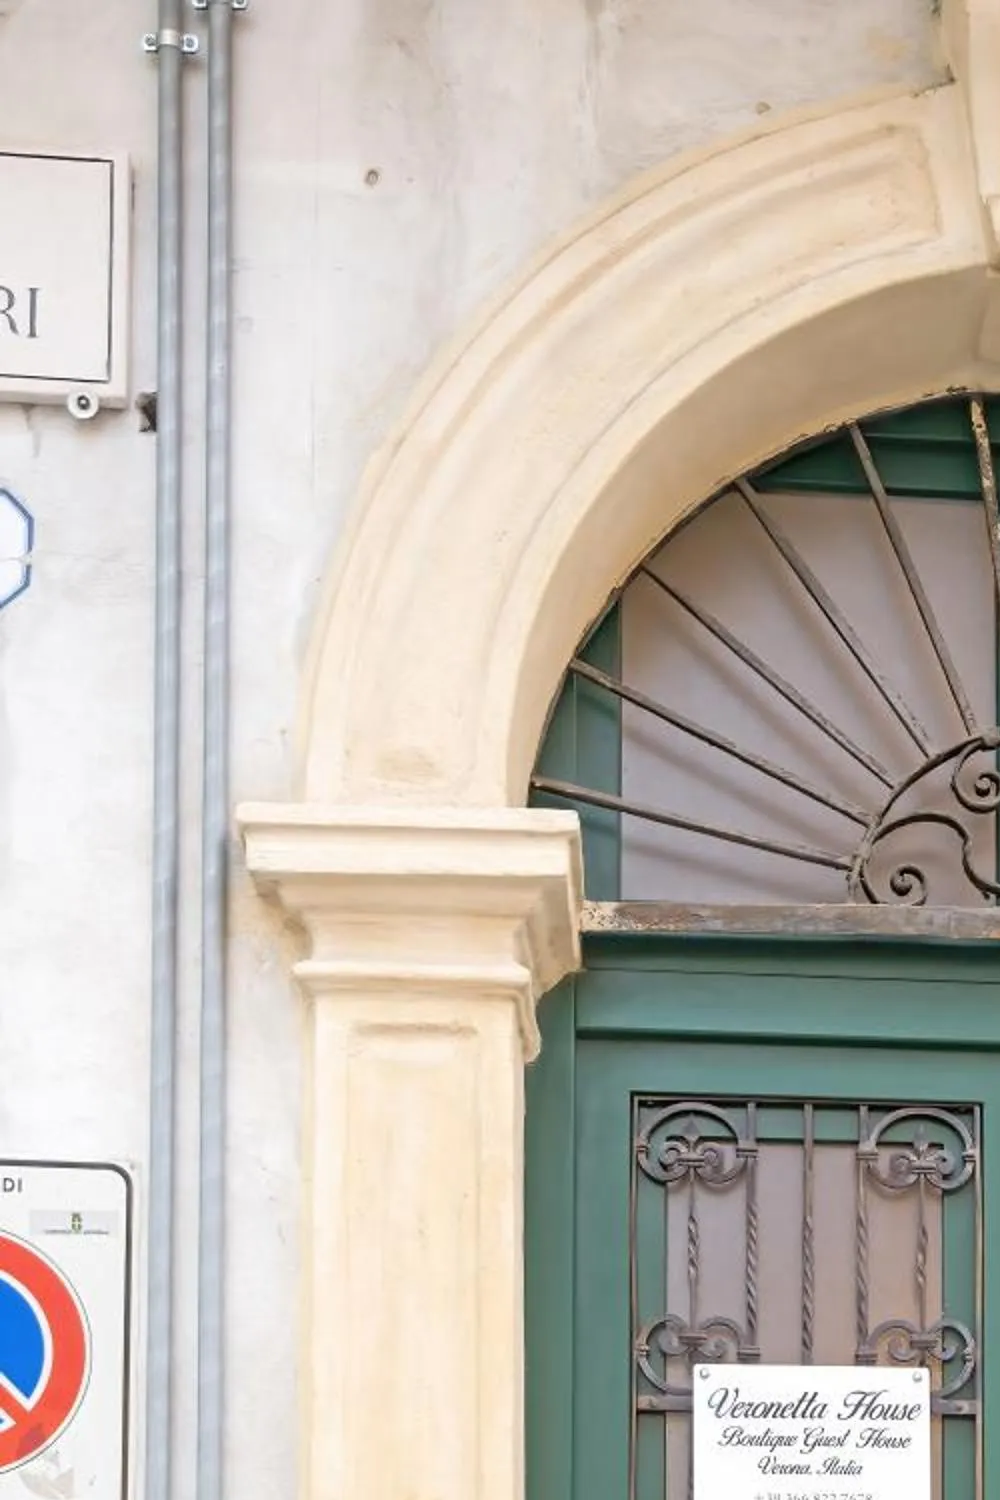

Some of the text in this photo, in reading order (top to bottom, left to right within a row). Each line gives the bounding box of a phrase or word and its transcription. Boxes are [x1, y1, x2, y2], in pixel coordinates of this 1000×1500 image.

[2, 1177, 23, 1193] DI
[708, 1387, 922, 1421] Veronetta House
[717, 1425, 912, 1455] Boutique Guest House
[816, 1456, 864, 1476] Italia
